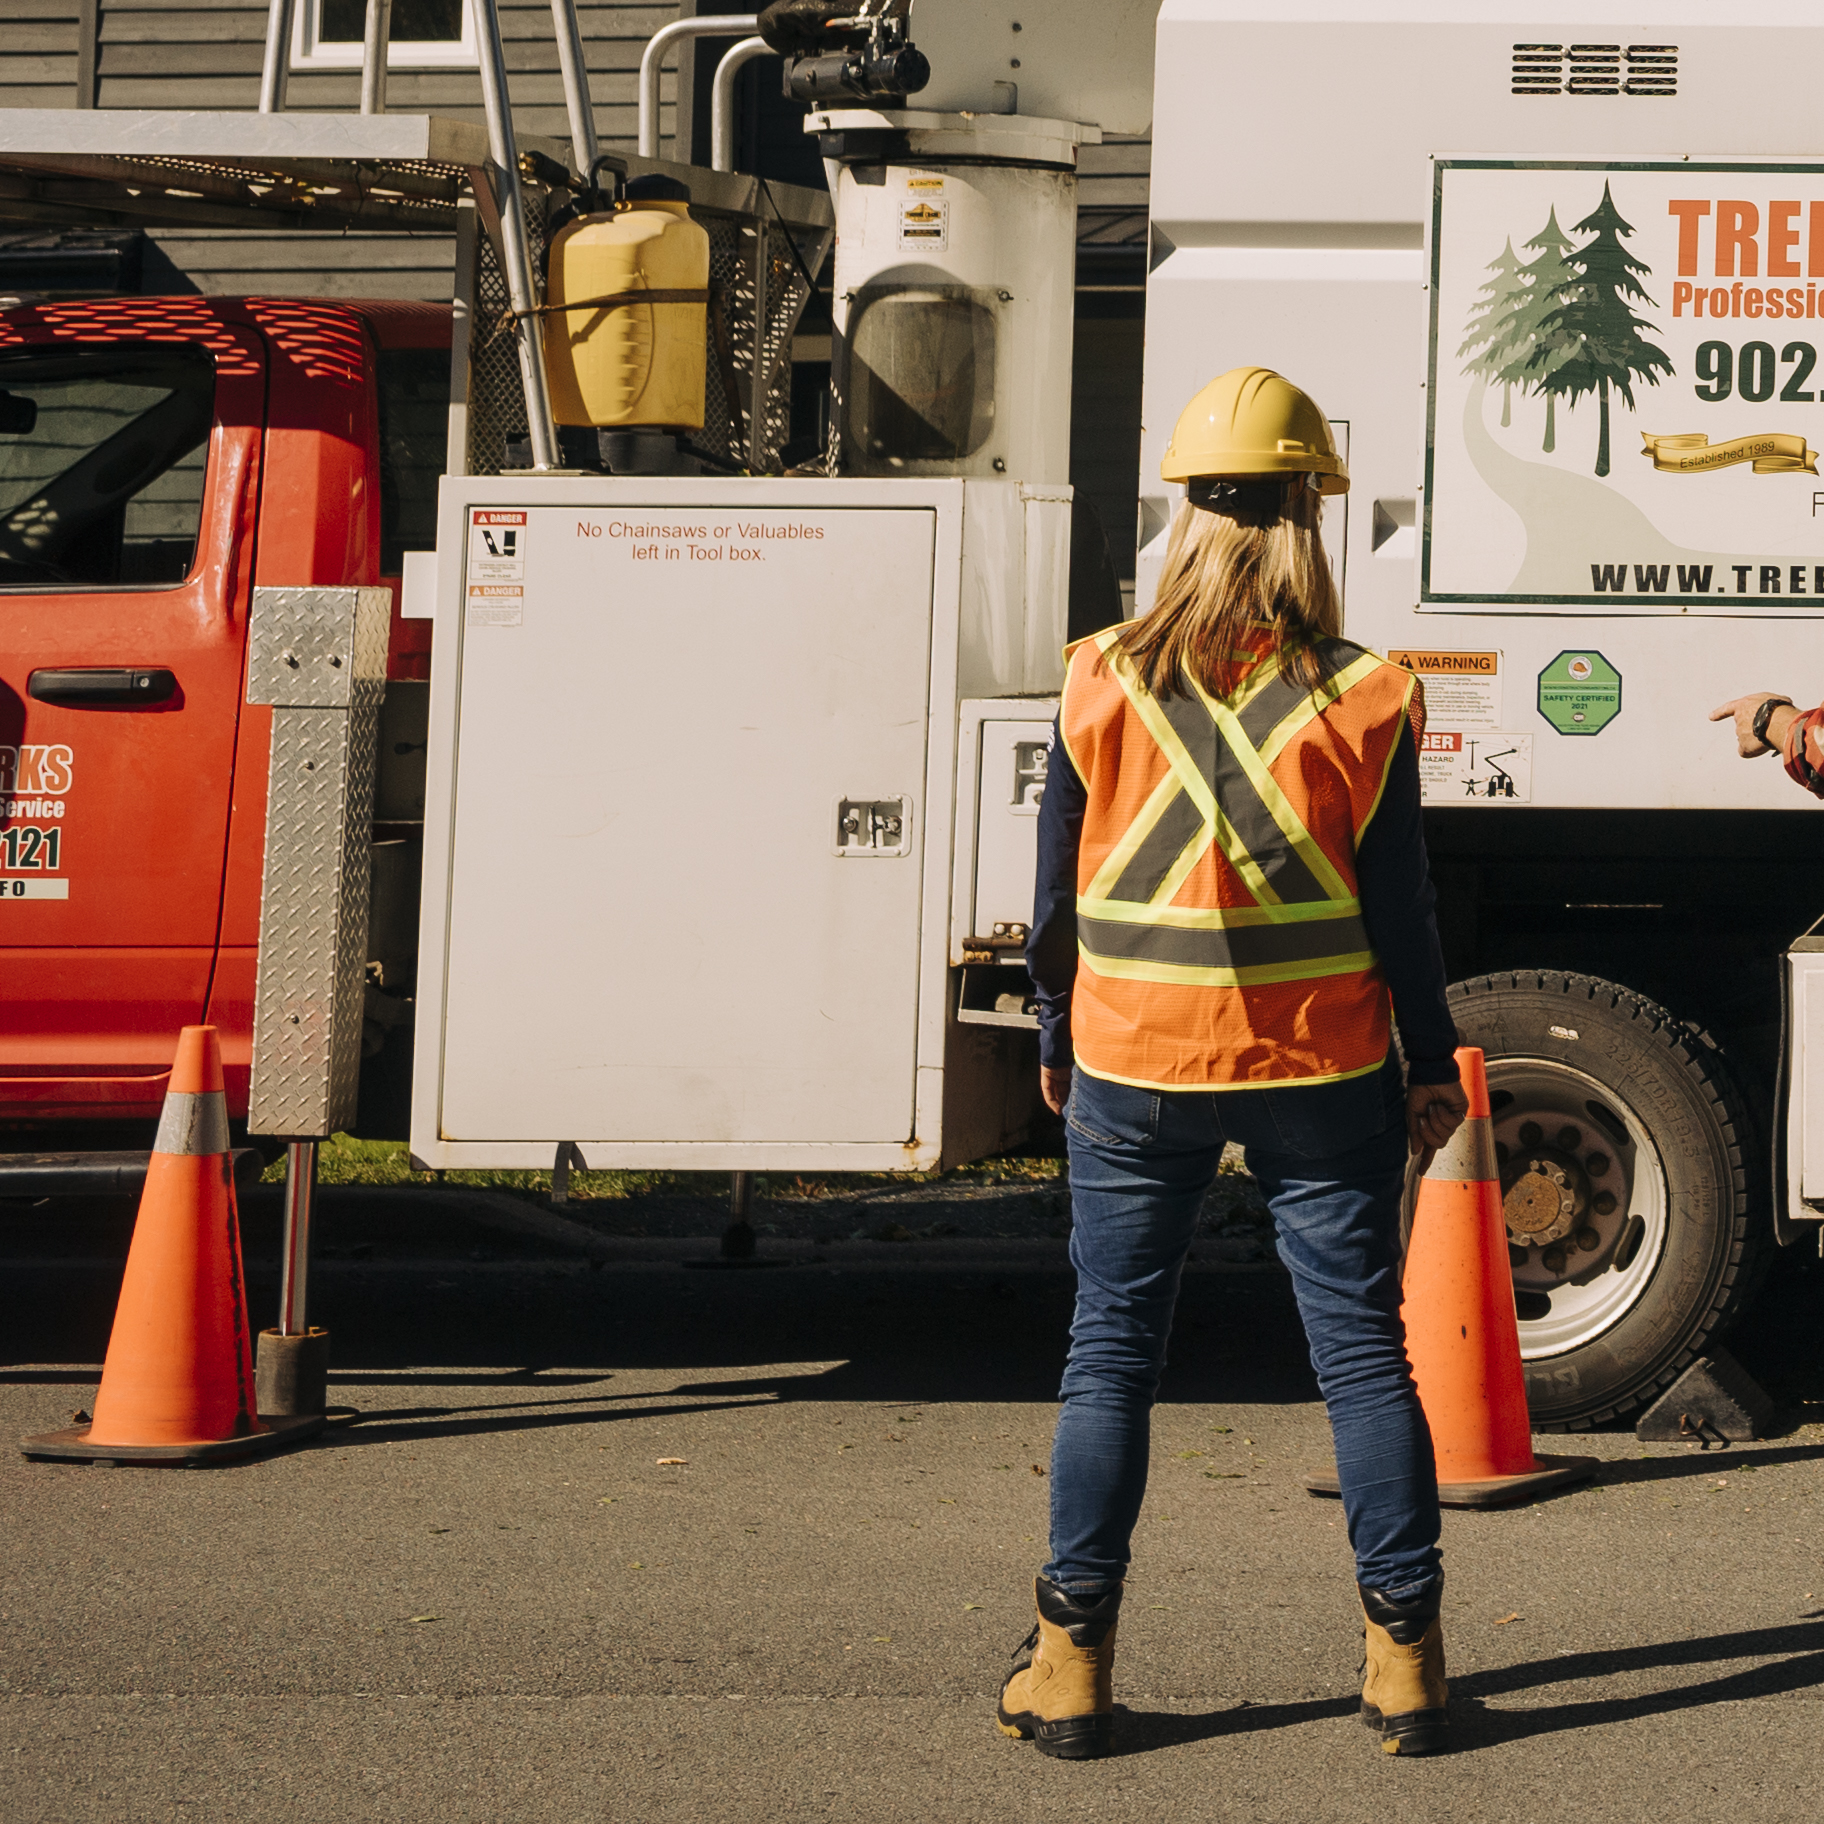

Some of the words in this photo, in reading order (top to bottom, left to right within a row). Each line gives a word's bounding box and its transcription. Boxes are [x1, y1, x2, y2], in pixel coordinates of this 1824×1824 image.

[1680, 446, 1744, 469] Established
[1748, 440, 1776, 456] 1989
[490, 513, 523, 523] DANGER
[577, 521, 602, 537] No
[608, 521, 707, 538] Chainsaws
[713, 525, 731, 538] or
[737, 522, 825, 539] Valuables
[632, 544, 659, 560] left
[665, 545, 680, 560] in
[687, 544, 723, 561] Tool
[729, 545, 766, 561] box.
[483, 587, 521, 596] DANGER
[1418, 656, 1491, 670] WARNING
[1421, 734, 1454, 749] GER
[0, 826, 61, 870] 121
